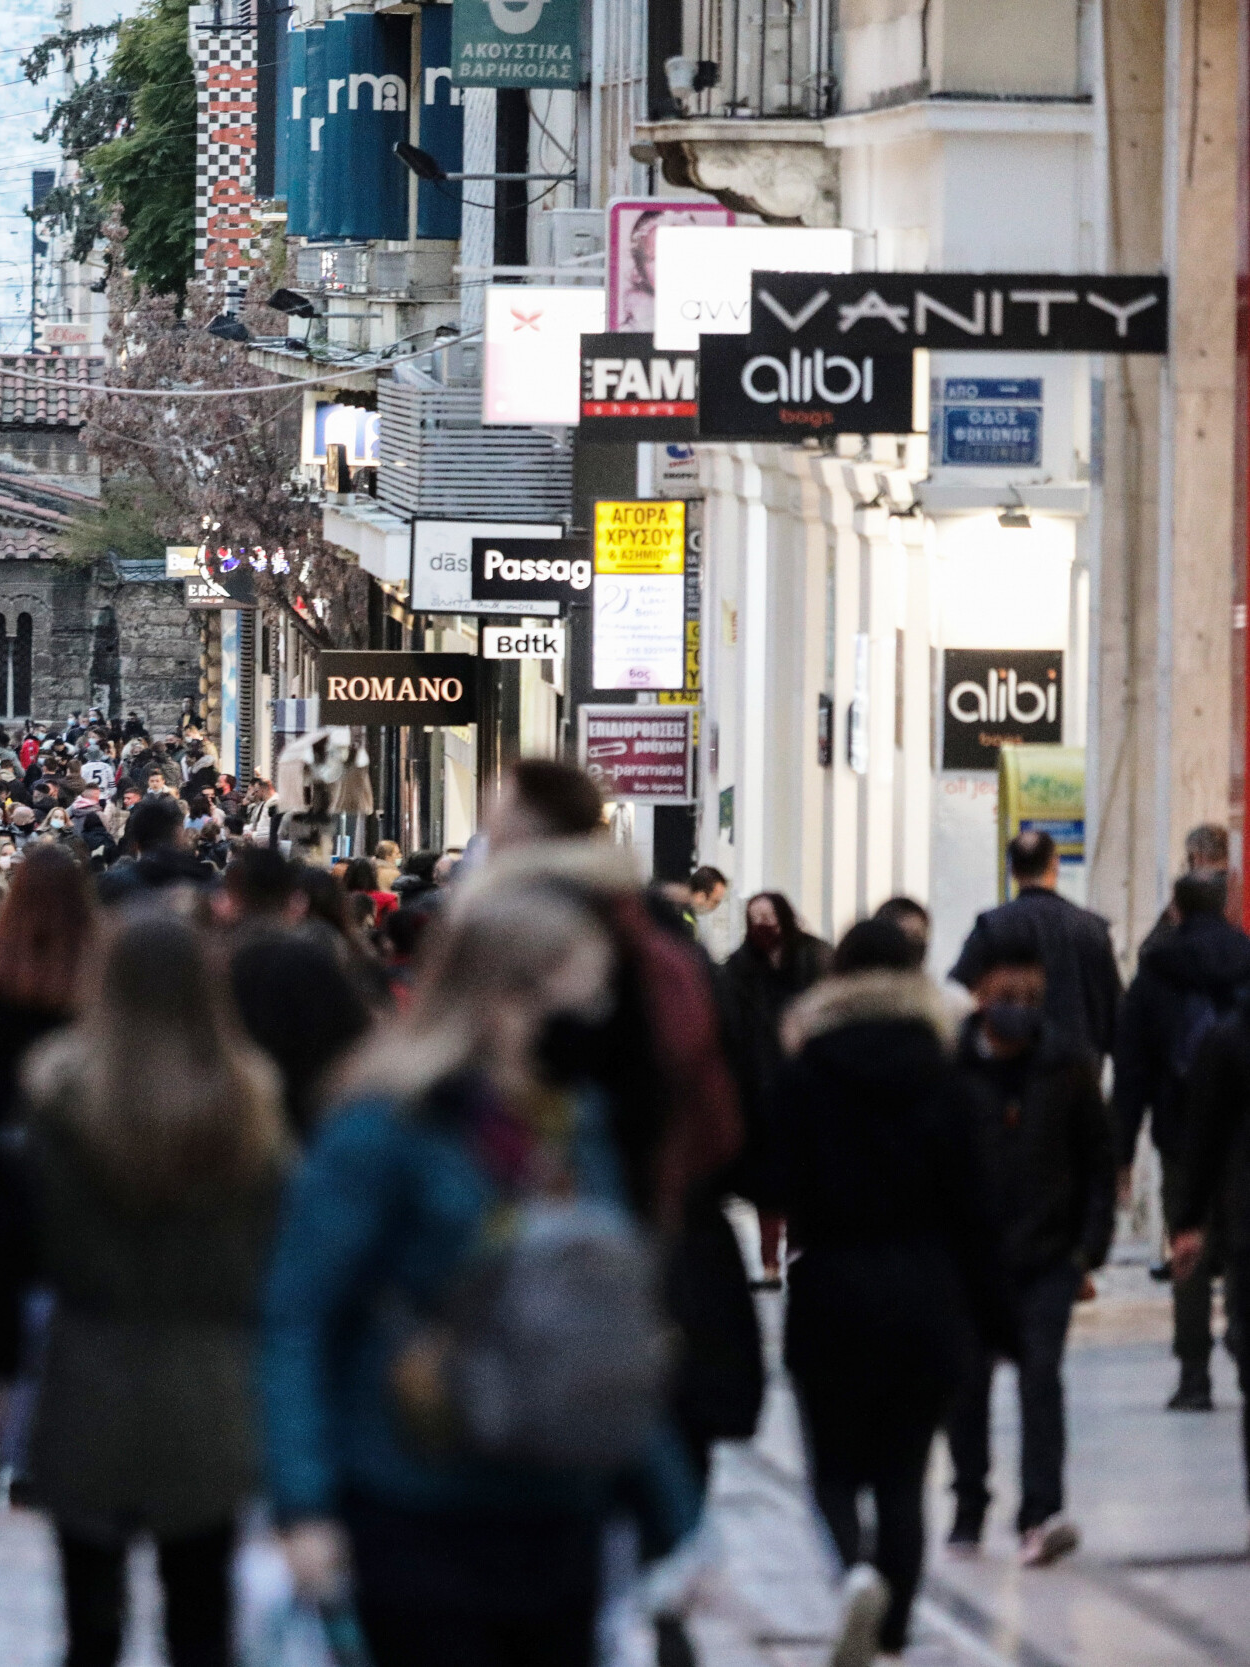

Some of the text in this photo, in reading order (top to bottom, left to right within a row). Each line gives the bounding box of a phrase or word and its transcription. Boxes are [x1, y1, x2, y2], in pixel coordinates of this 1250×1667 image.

[461, 43, 572, 59] ΑΚΟΥΣΤΙΚΑ
[758, 289, 1157, 337] VANITY
[593, 358, 699, 400] FAM
[741, 348, 873, 403] alibi
[613, 508, 668, 525] ΑΓΟΡΑ
[607, 529, 675, 546] ΧΡΥΣΟΥ
[497, 634, 558, 654] Bdtk
[327, 676, 463, 702] ROMANO
[948, 667, 1057, 724] alibi
[92, 769, 103, 785] 5
